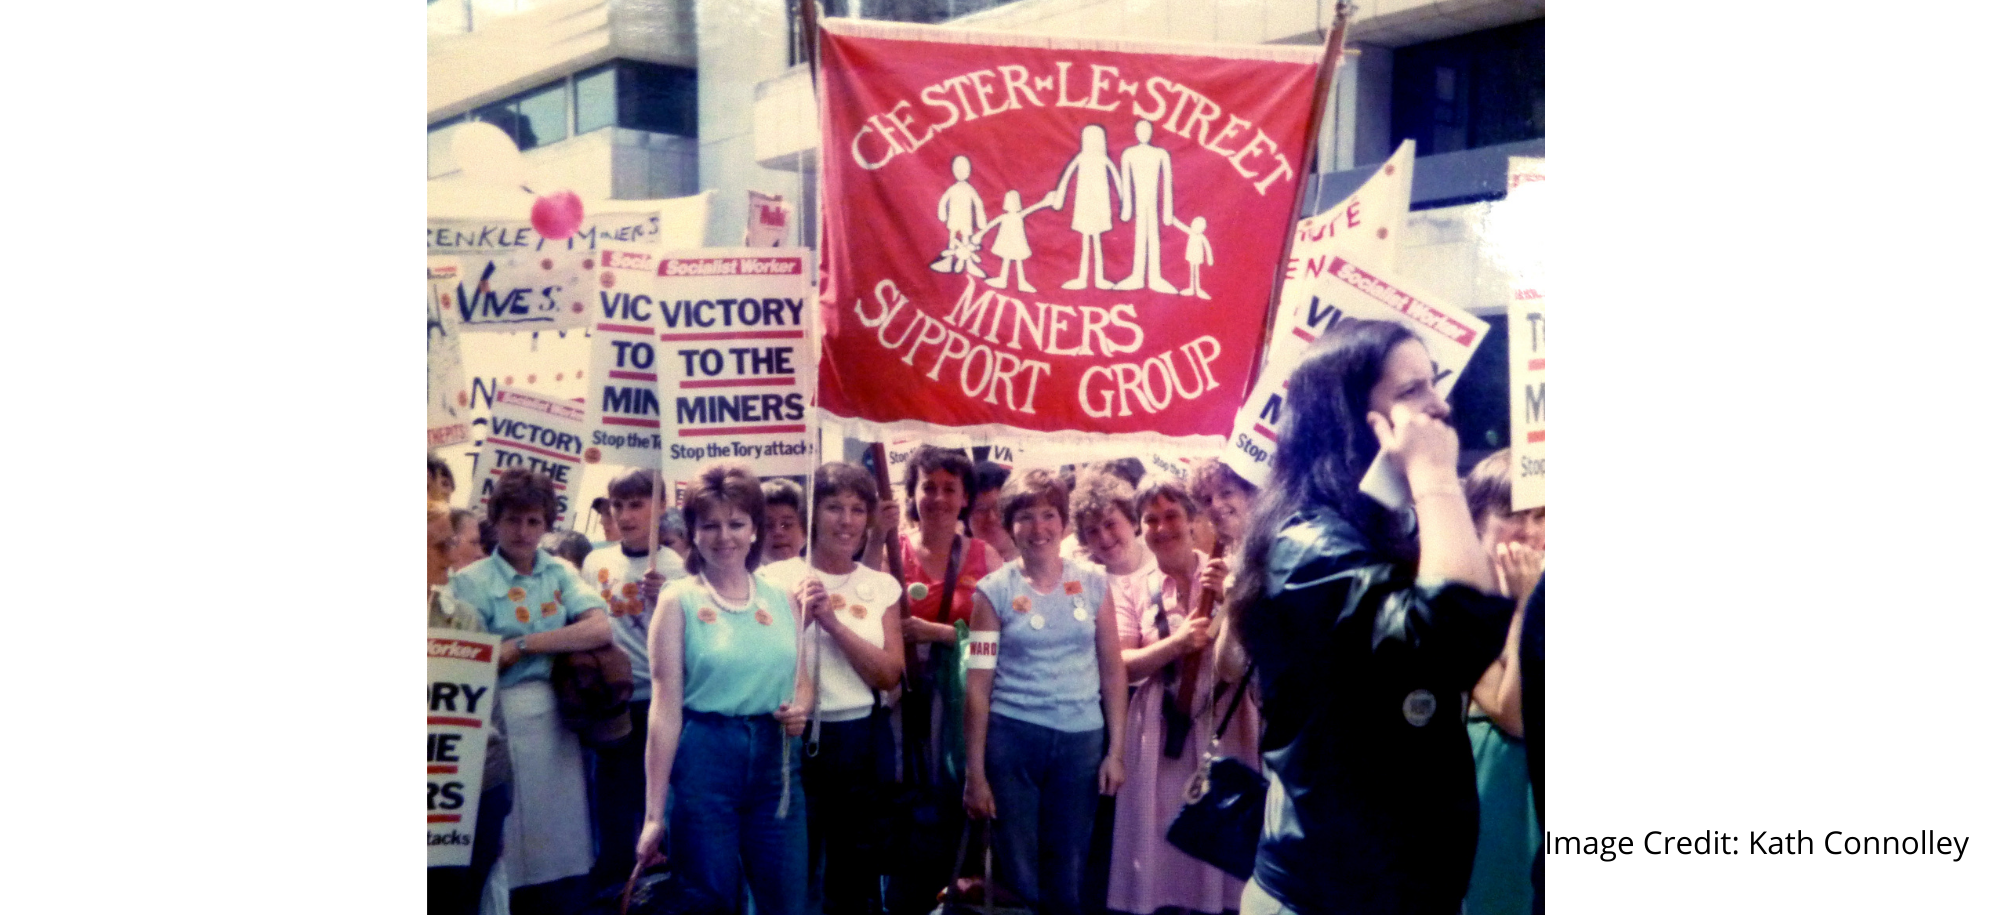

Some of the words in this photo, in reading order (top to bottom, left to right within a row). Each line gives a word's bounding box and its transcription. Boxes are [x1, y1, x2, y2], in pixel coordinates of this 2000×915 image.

[666, 259, 737, 275] Socialist
[740, 259, 797, 274] Worker
[659, 297, 804, 329] VICTORY
[942, 274, 1144, 357] MINERS
[1338, 262, 1405, 313] Socialist
[1408, 301, 1465, 341] Worker
[611, 340, 656, 371] TO
[677, 348, 724, 377] TO
[728, 346, 795, 376] THE
[853, 278, 1050, 415] SUPPORT
[1078, 334, 1222, 418] GROUP
[675, 393, 805, 425] MINERS
[592, 430, 625, 450] Stop
[627, 432, 650, 450] the
[669, 443, 706, 462] Stop
[707, 442, 731, 459] the
[731, 441, 764, 460] Tory
[1236, 433, 1268, 463] Stop
[427, 637, 483, 660] orker
[427, 681, 488, 713] RY
